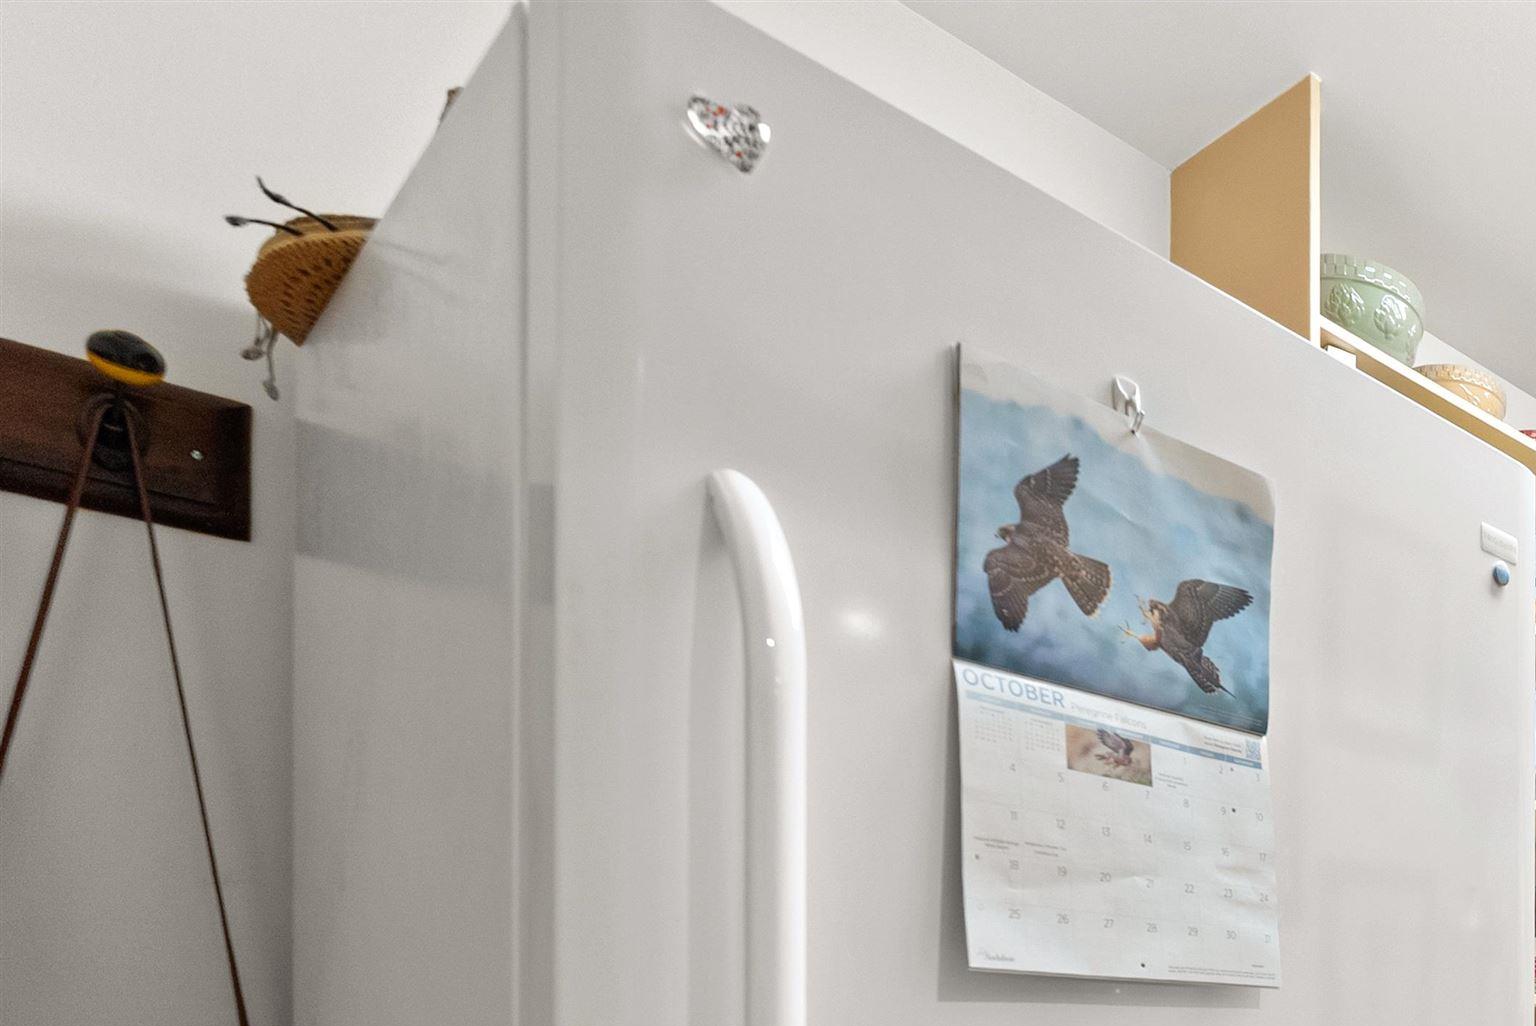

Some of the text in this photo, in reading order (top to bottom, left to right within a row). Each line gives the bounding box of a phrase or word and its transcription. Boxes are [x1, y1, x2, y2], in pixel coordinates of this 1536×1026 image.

[962, 668, 1066, 709] OCTOBER
[1056, 819, 1065, 830] 12
[1102, 826, 1110, 837] 13
[1057, 866, 1067, 876] 19
[1100, 872, 1111, 882] 20
[1184, 883, 1194, 894] 22
[1223, 888, 1233, 899] 23
[1009, 908, 1021, 919] 25
[1057, 913, 1069, 924] 26
[1104, 918, 1114, 928] 27
[1147, 922, 1158, 933] 28
[1188, 926, 1199, 936] 29
[1226, 930, 1237, 940] 30
